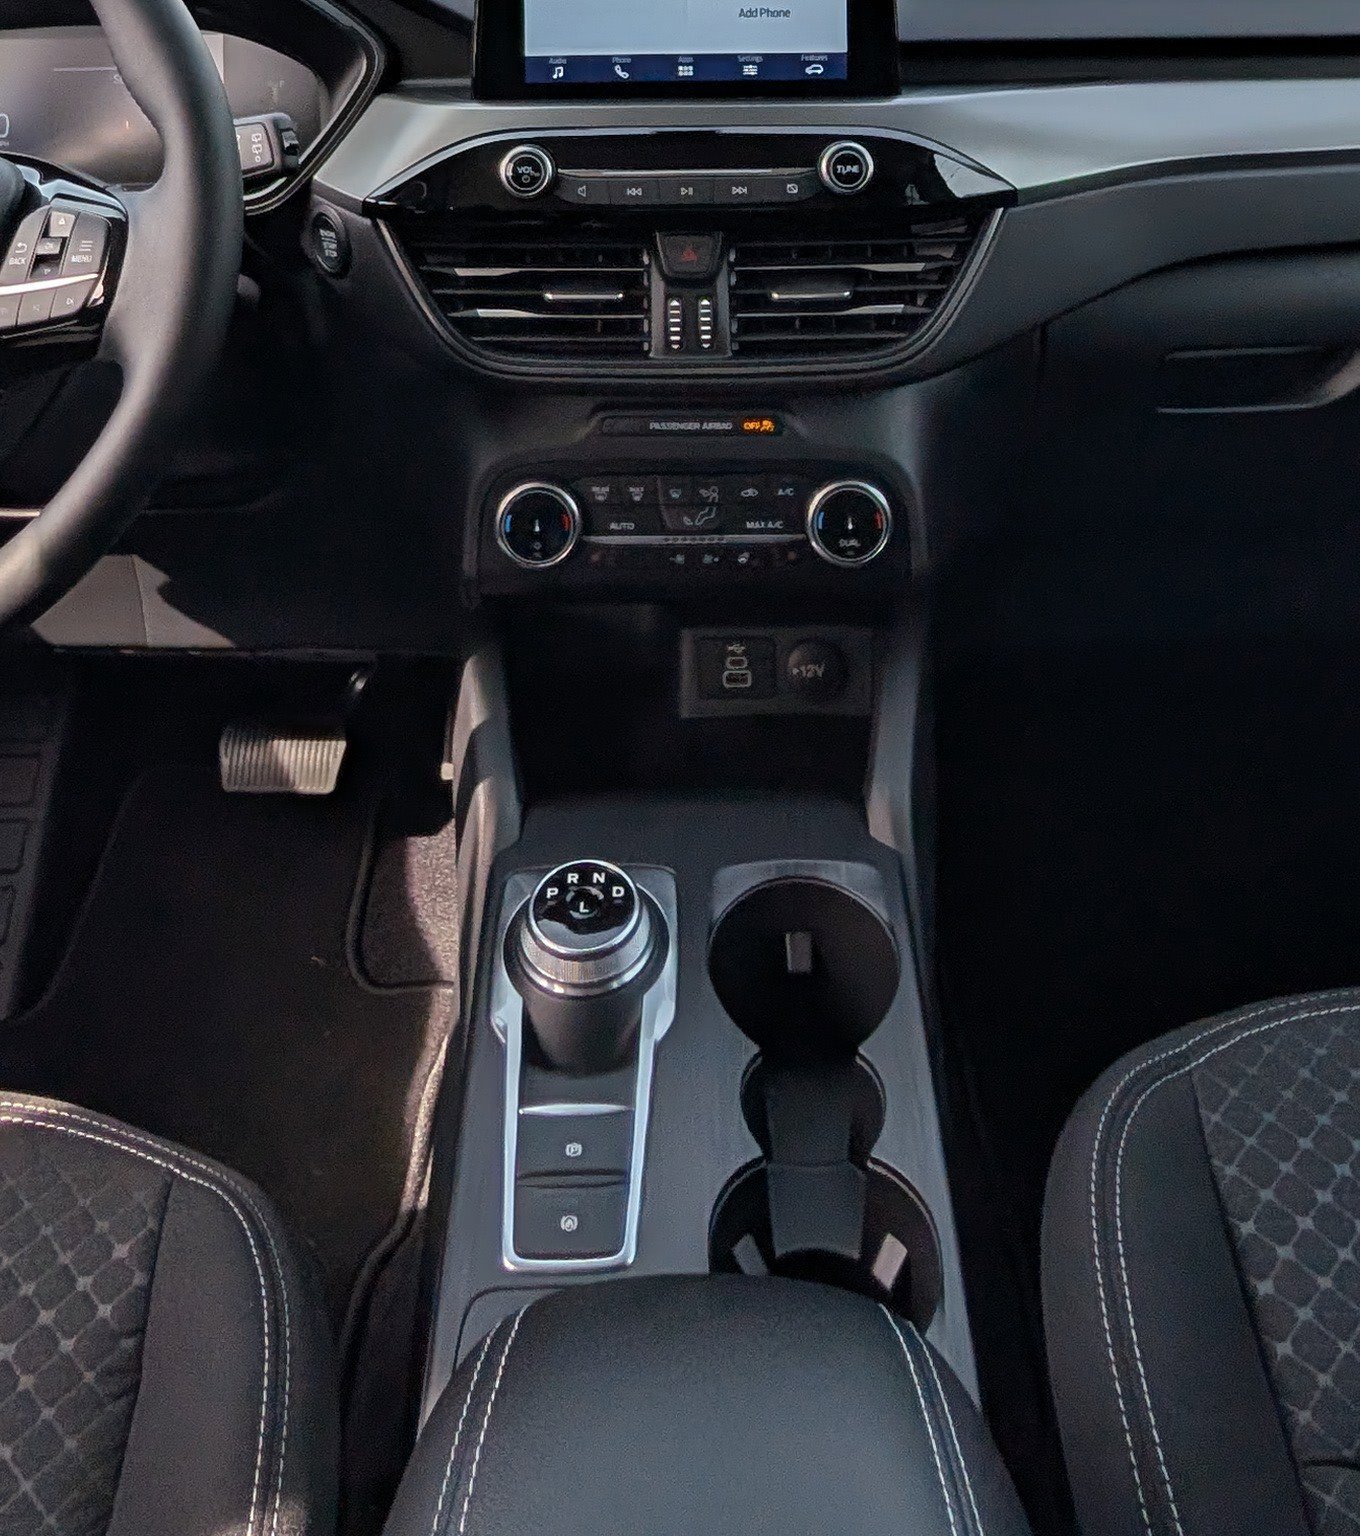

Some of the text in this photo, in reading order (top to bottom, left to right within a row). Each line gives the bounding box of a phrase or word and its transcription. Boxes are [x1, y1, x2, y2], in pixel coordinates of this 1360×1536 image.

[739, 7, 792, 19] Add Phone
[836, 164, 860, 175] TUNE
[70, 254, 93, 263] MENU
[649, 421, 700, 431] PASSENGER
[701, 421, 733, 431] AIRBAG
[609, 521, 635, 531] AUTO
[545, 871, 626, 900] P R N D
[579, 900, 590, 913] L
